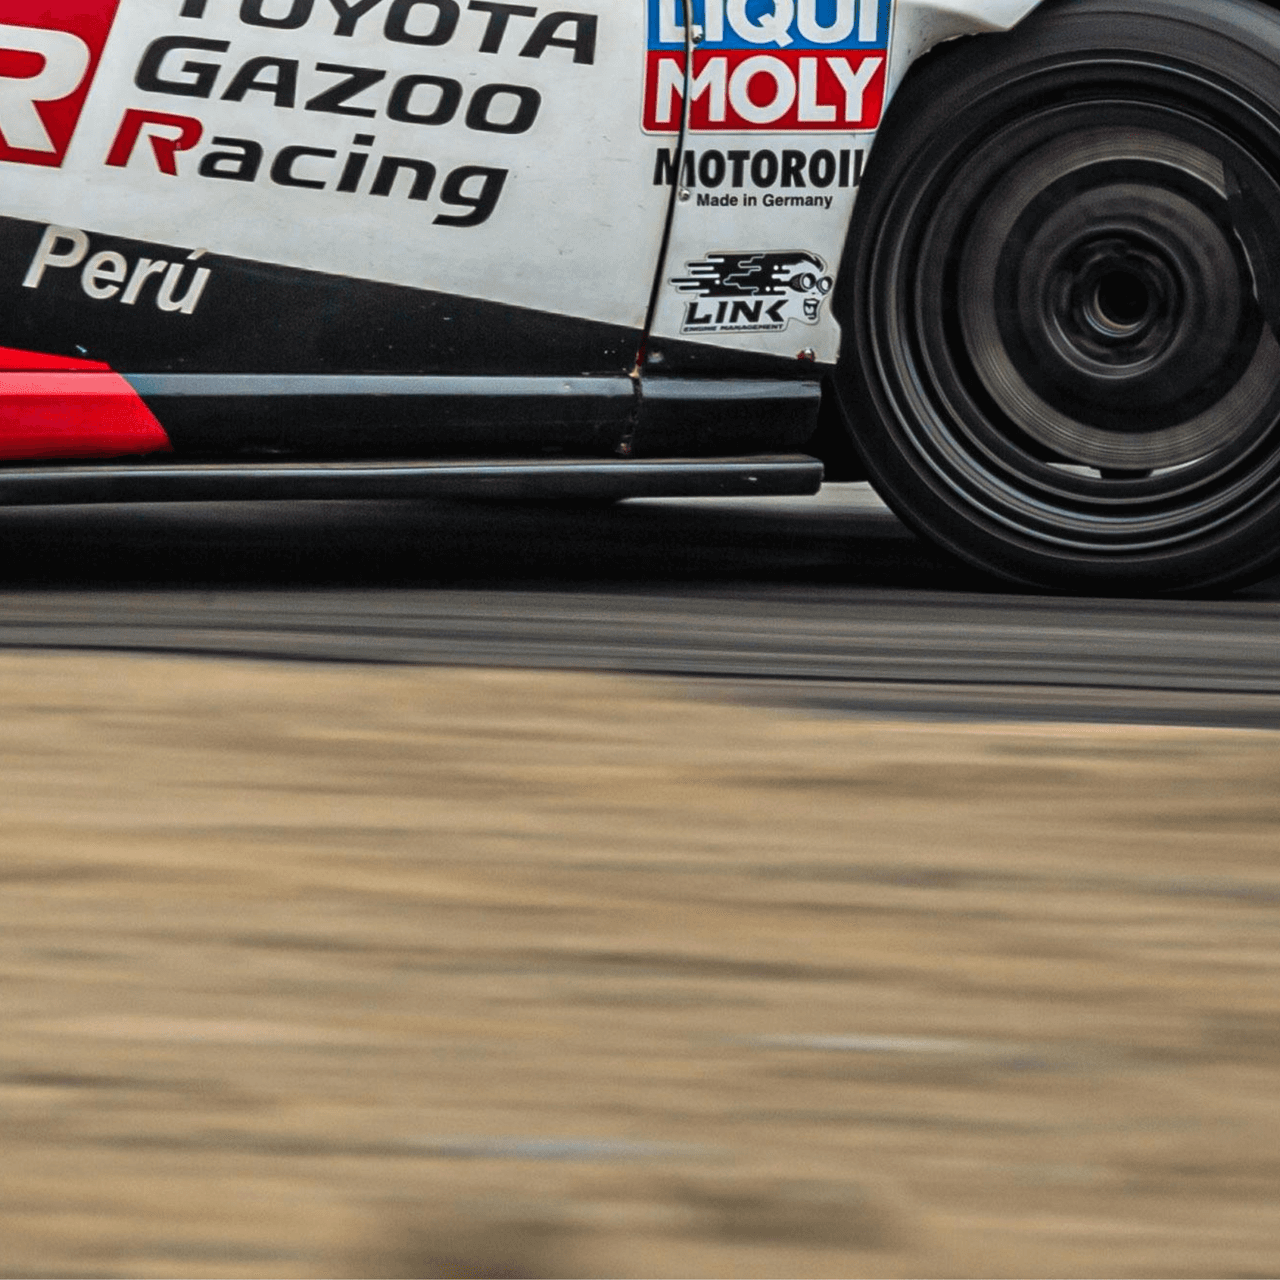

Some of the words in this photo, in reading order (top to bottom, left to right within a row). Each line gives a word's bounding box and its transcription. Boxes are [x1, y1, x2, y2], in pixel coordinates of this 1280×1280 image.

[134, 34, 542, 135] GAZOO
[654, 55, 884, 125] MOLY
[105, 108, 509, 229] Racing
[697, 194, 738, 207] Made
[743, 194, 757, 207] in
[762, 194, 833, 210] Germany
[23, 224, 210, 316] Perú
[685, 300, 789, 325] LINK
